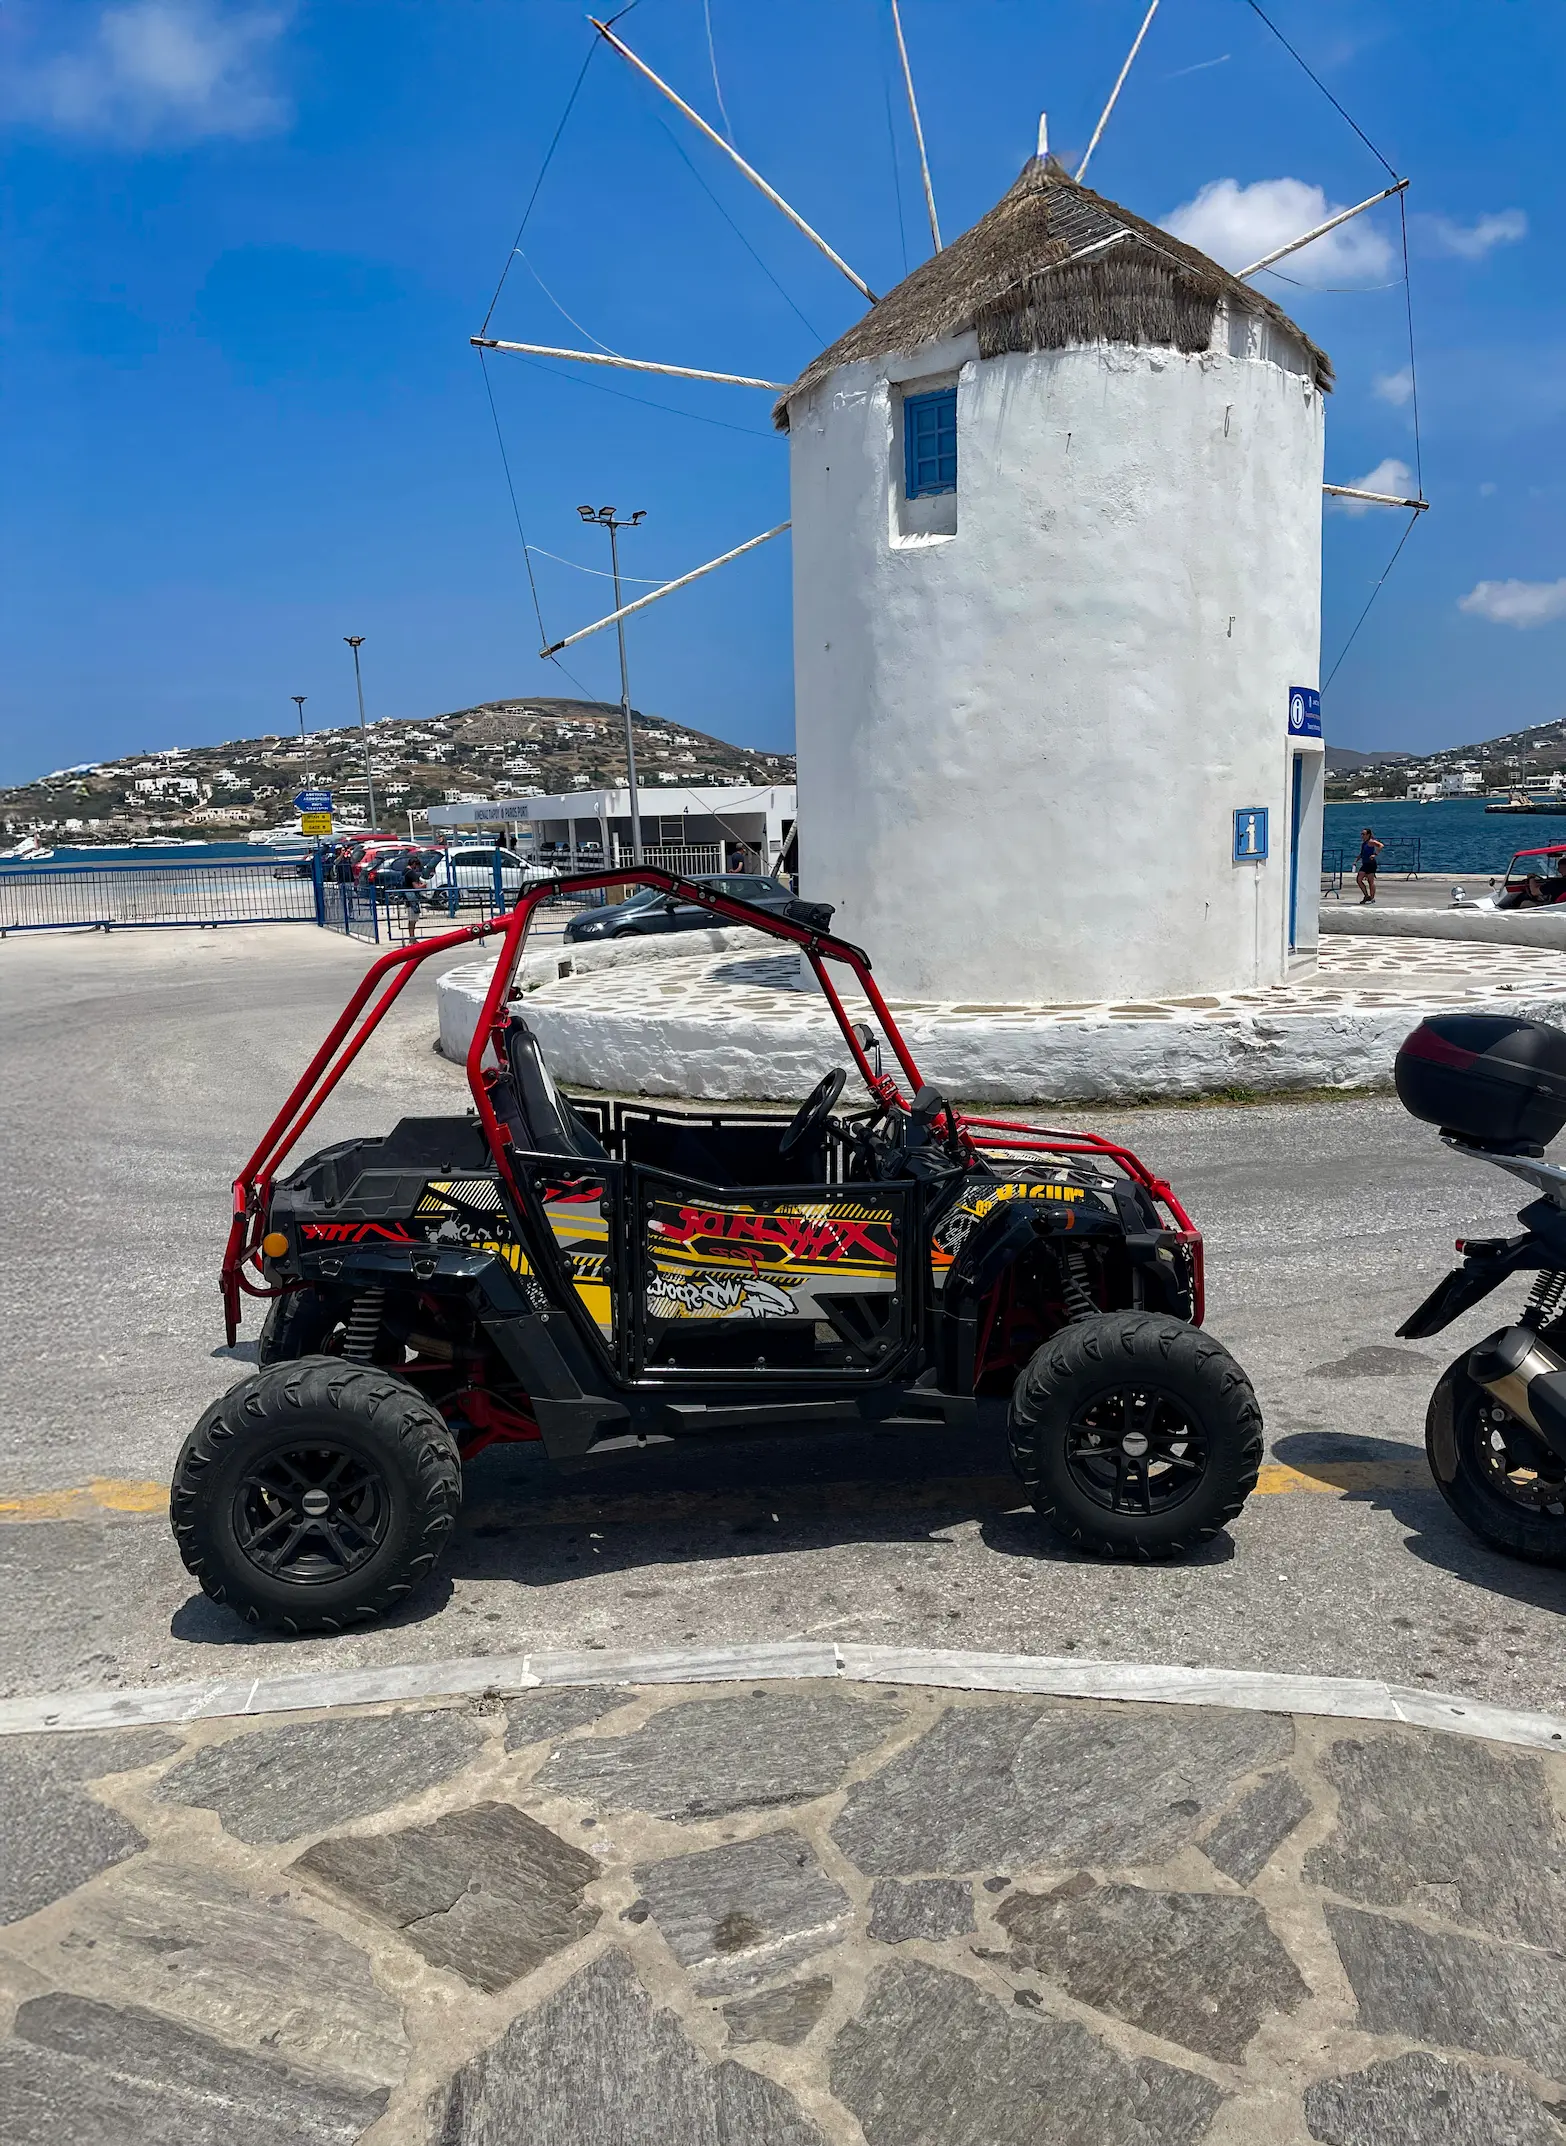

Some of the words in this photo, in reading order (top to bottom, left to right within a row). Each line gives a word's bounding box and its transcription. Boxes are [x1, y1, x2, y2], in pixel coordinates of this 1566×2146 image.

[505, 807, 517, 818] PAROS
[517, 806, 528, 817] PORT
[683, 805, 689, 814] 4
